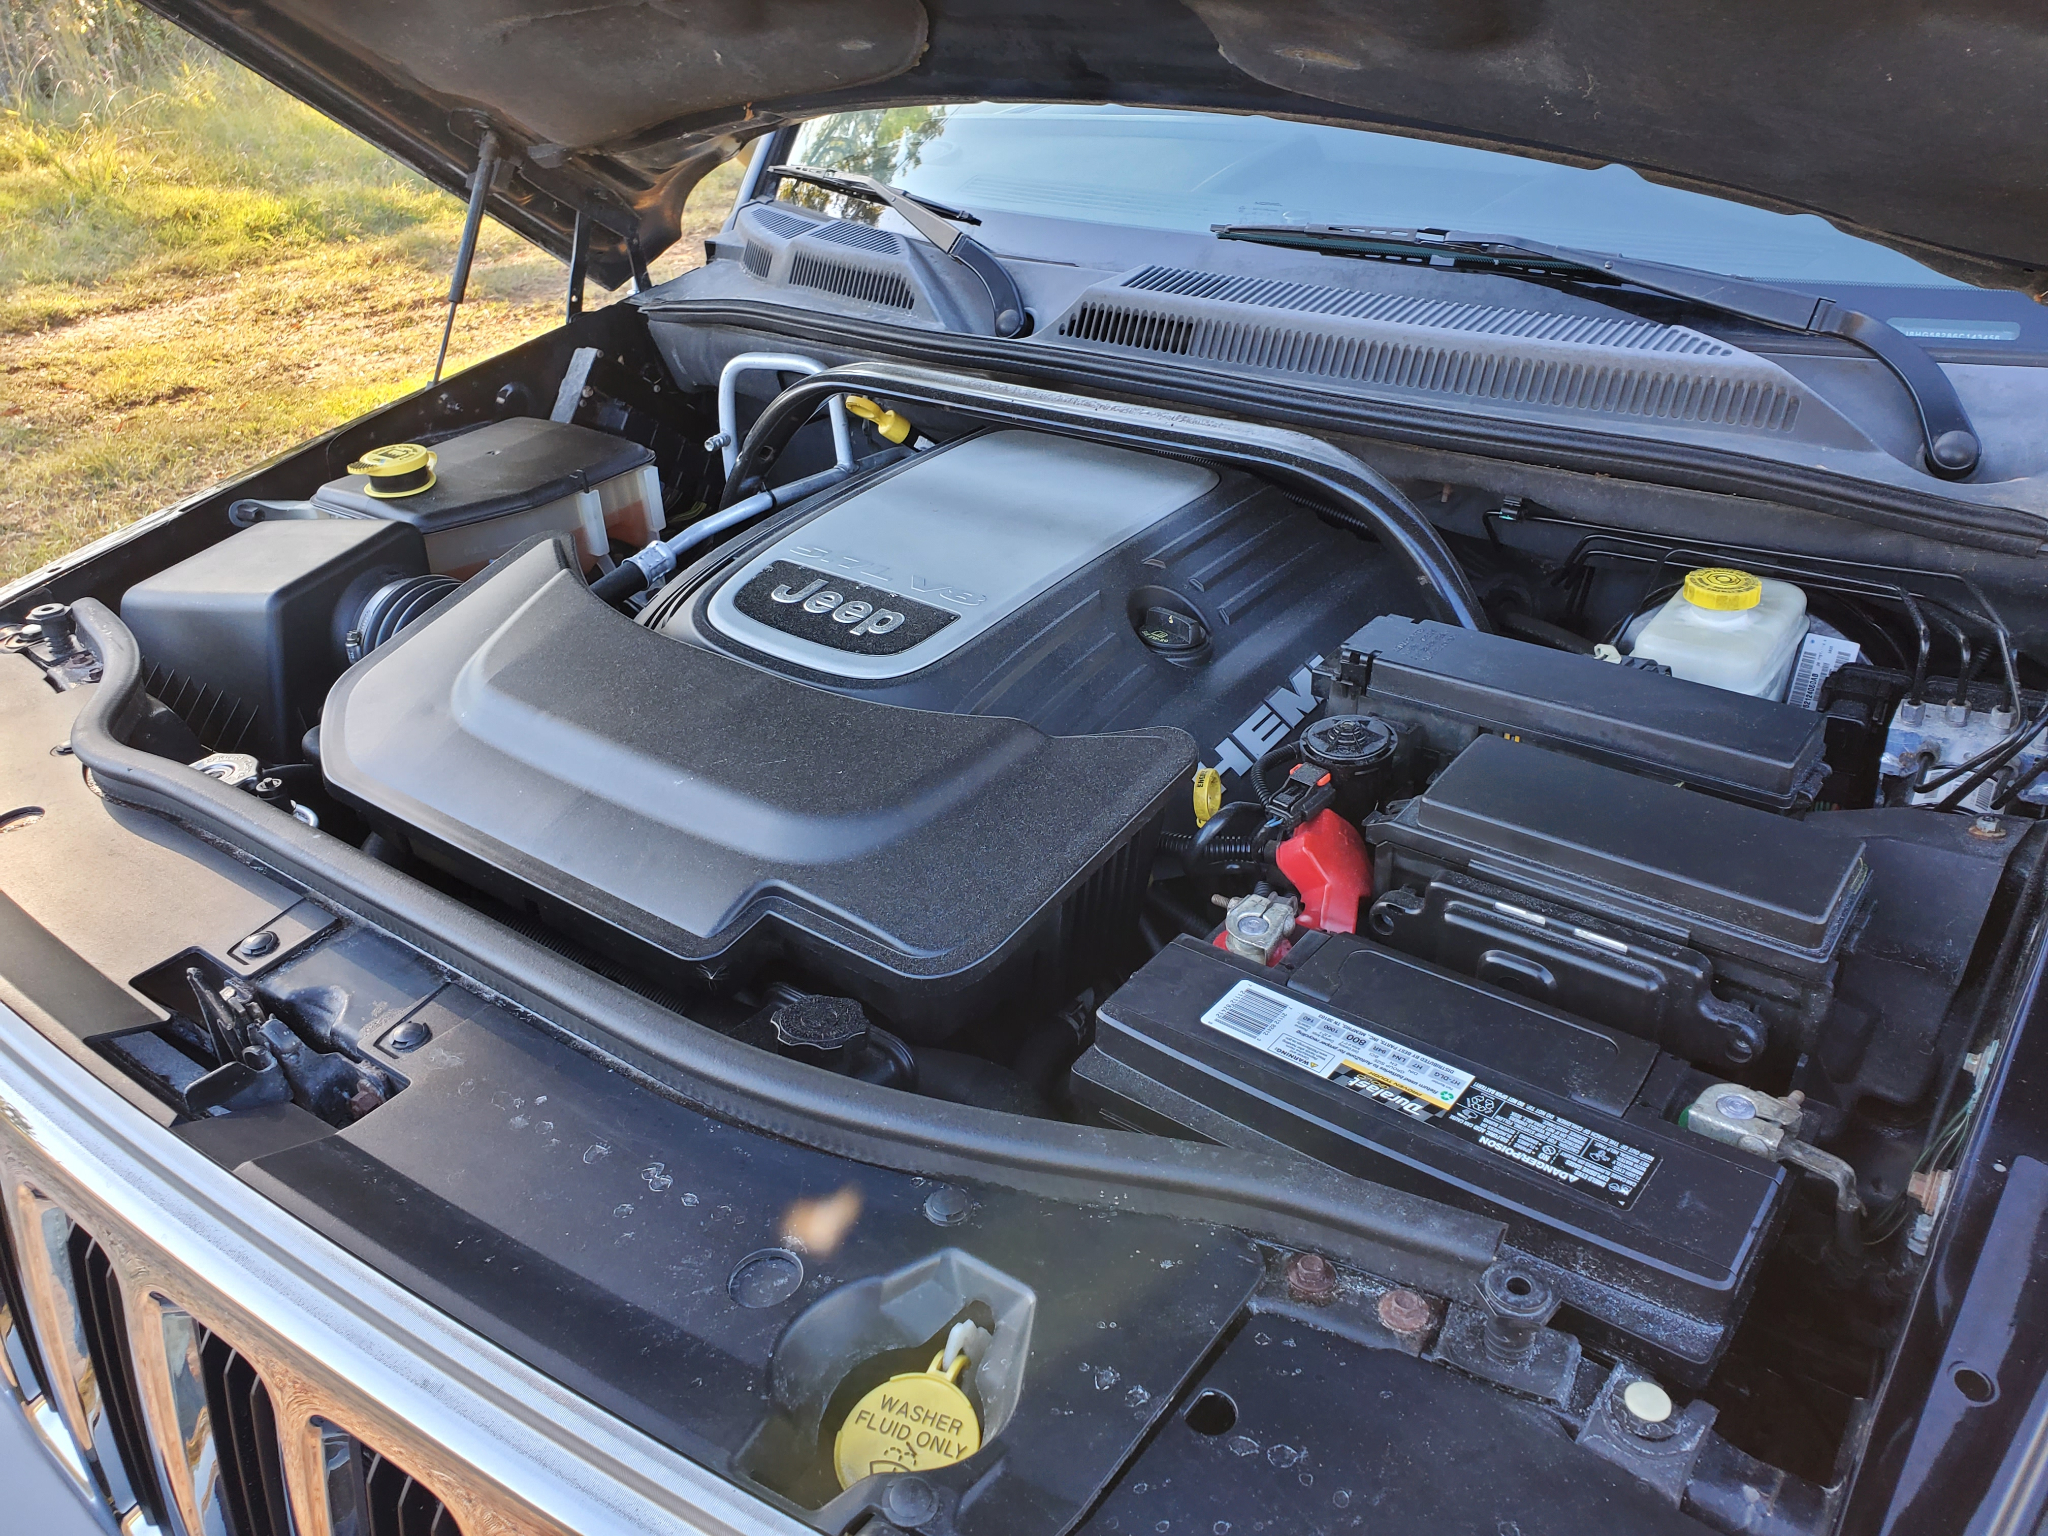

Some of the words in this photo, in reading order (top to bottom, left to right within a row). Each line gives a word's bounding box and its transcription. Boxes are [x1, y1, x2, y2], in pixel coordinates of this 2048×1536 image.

[911, 574, 986, 606] V8
[771, 578, 905, 636] Jeep
[1301, 1015, 1315, 1023] 140
[1322, 1024, 1340, 1033] 1000
[1344, 1033, 1367, 1046] 800
[1371, 1045, 1387, 1054] 94R
[1396, 1047, 1412, 1056] BEST
[1343, 1051, 1373, 1066] AutoZone
[1390, 1053, 1406, 1062] LN4
[1377, 1065, 1404, 1079] batteries
[1418, 1056, 1455, 1074] DISTRIBUTED
[1355, 1072, 1391, 1090] GOLD
[1367, 1070, 1392, 1083] TOUGH
[1402, 1076, 1418, 1085] used
[1432, 1071, 1461, 1085] H7-DLG
[1392, 1081, 1423, 1096] PROVEN
[1416, 1082, 1439, 1094] Return
[1346, 1075, 1426, 1116] Duralast
[1475, 1135, 1571, 1180] DANGER/POISON
[1536, 1151, 1551, 1162] NO
[880, 1394, 963, 1436] WASHER
[855, 1410, 912, 1441] FLUID
[915, 1430, 968, 1460] ONLY
